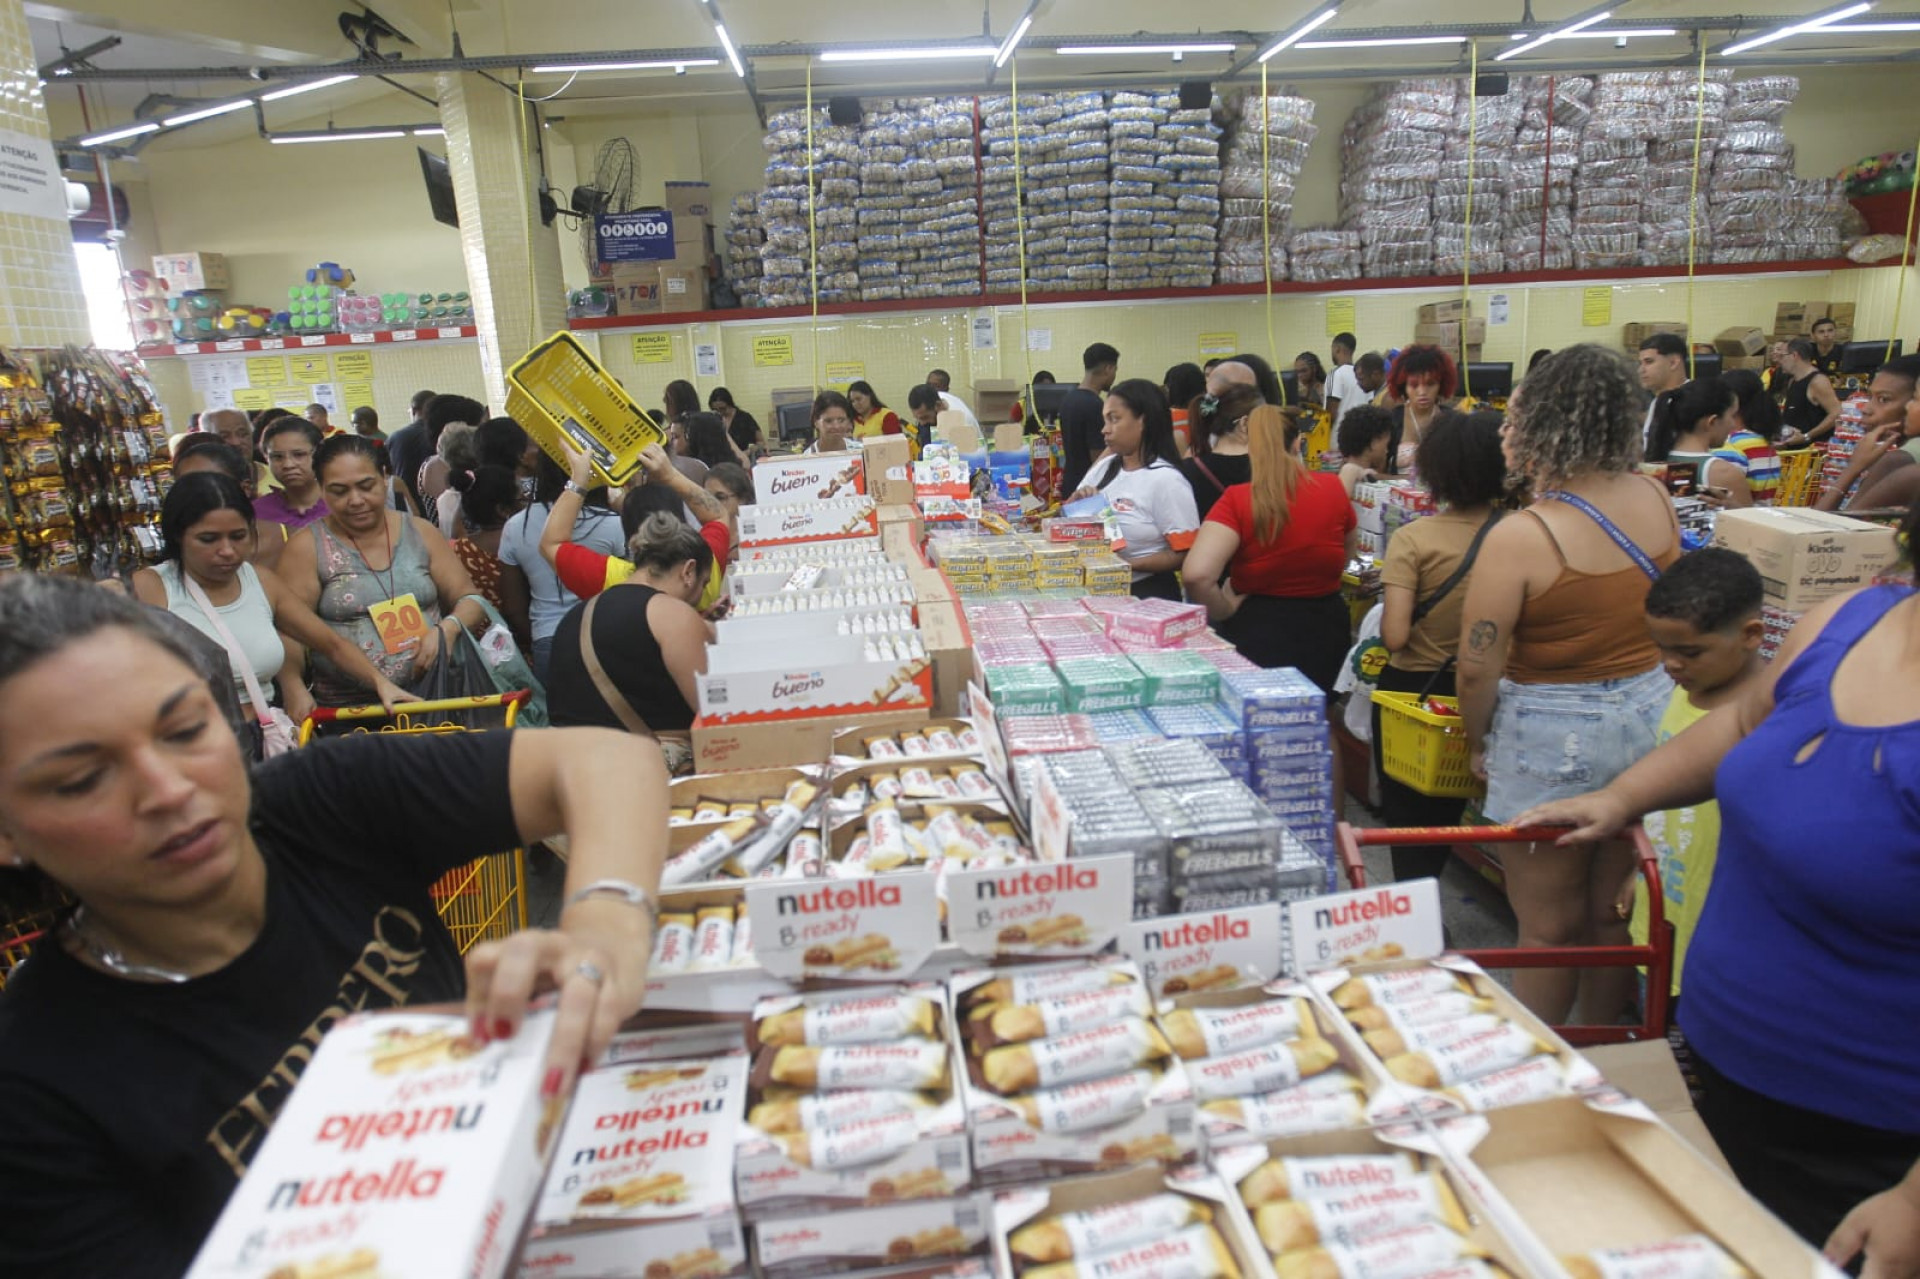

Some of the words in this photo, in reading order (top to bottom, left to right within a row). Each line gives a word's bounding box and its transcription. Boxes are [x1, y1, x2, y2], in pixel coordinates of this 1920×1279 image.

[757, 338, 787, 346] ATENÇÃO
[770, 474, 819, 495] bueno
[377, 605, 423, 639] 20
[771, 677, 825, 699] bueno
[1249, 711, 1319, 726] FREEGELLS
[1257, 741, 1324, 758] FREEGELLS
[976, 863, 1098, 899] nutella
[1181, 851, 1274, 875] FREEGELLS
[777, 878, 902, 916] nutella
[1315, 890, 1412, 930] nutella
[1144, 913, 1250, 951] nutella
[1316, 923, 1381, 961] B-ready
[1210, 1003, 1285, 1028] nutella
[316, 1103, 484, 1151] nutella
[594, 1098, 725, 1134] nutella
[572, 1127, 710, 1167] nutella
[267, 1157, 445, 1213] nutella
[1302, 1162, 1396, 1189] nutella
[1094, 1241, 1190, 1278] nutella
